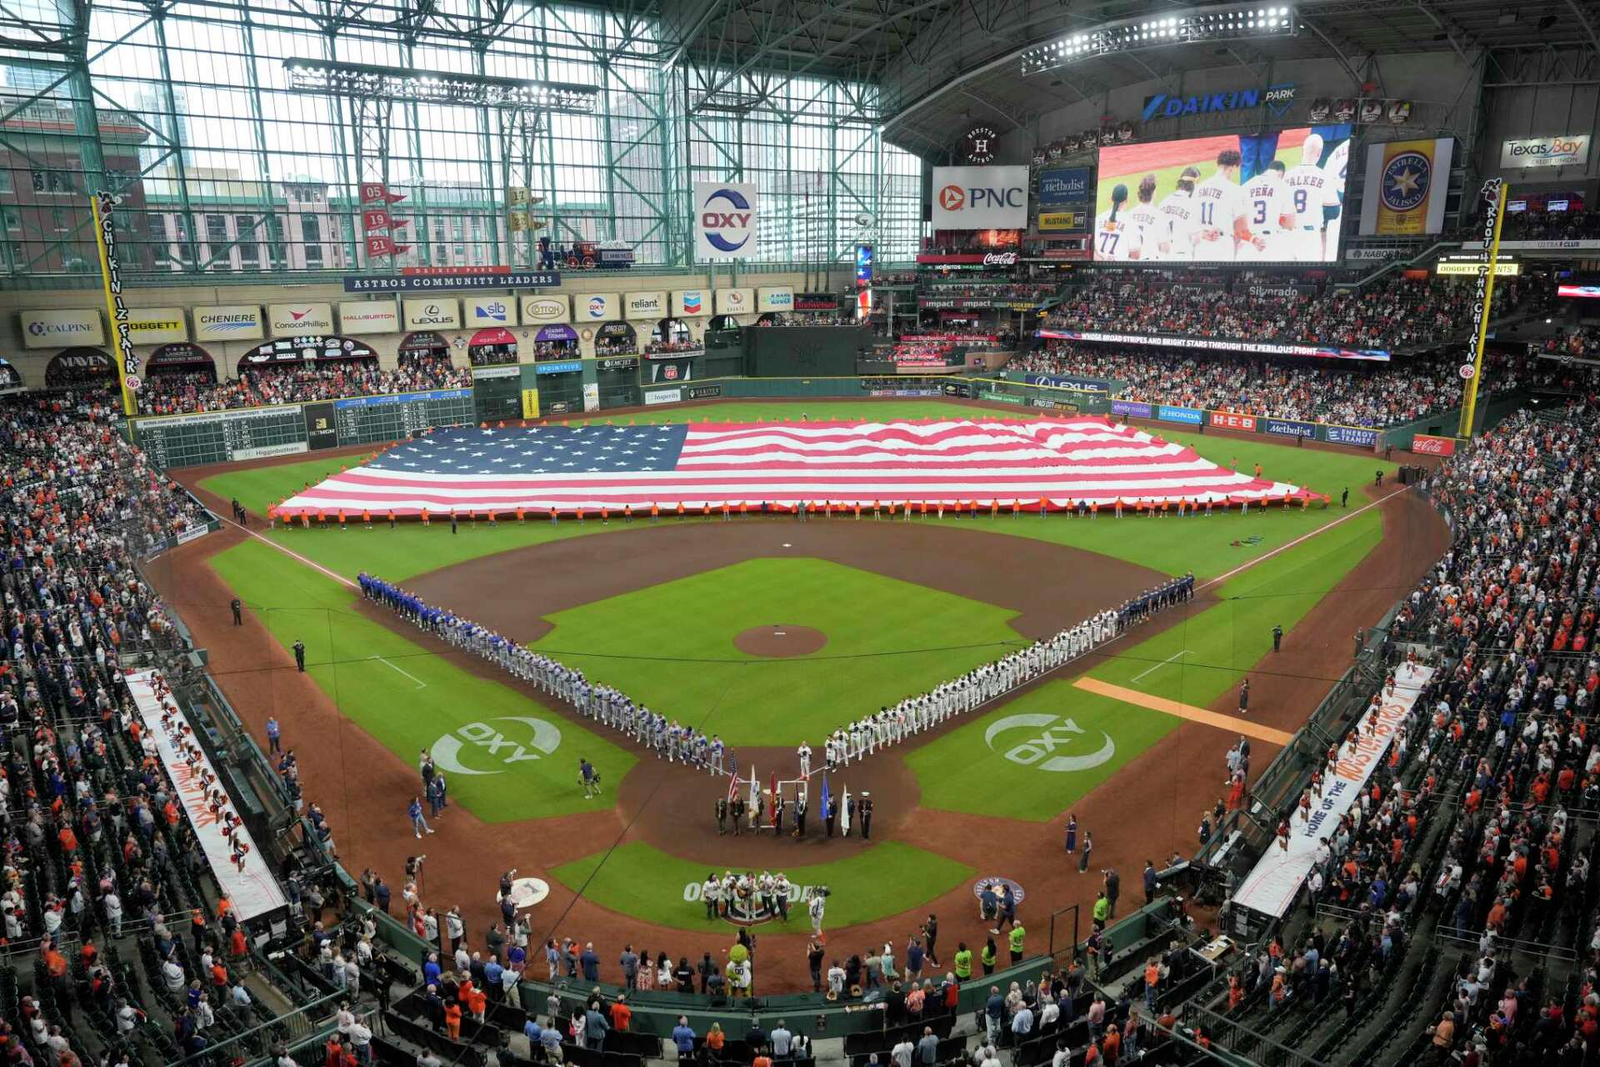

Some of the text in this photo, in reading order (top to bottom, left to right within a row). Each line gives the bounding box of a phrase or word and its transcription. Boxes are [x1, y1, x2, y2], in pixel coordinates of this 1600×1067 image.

[1265, 88, 1296, 101] PARK
[1165, 88, 1260, 117] DAIKIN
[967, 127, 995, 139] HOUSTON
[975, 139, 988, 152] H
[1508, 139, 1583, 157] Texas Bay
[1387, 157, 1428, 175] ESTRELLA
[1555, 156, 1578, 164] UNION
[1043, 178, 1084, 192] Methodist
[366, 186, 381, 197] 05
[968, 187, 1024, 208] PNC
[1198, 187, 1223, 199] SMITH
[1294, 189, 1307, 213] 8
[1387, 194, 1422, 206] JALISCO
[1201, 202, 1214, 225] 11
[1253, 200, 1266, 224] 3
[370, 214, 384, 225] 19
[702, 212, 752, 228] OXY
[1044, 216, 1071, 226] MUSTANG
[372, 240, 386, 250] 21
[1100, 232, 1119, 255] 77
[983, 252, 1018, 265] Coca-Cola
[354, 275, 553, 289] ASTROS COMMUNITY LEADERS
[488, 302, 506, 314] slb
[631, 299, 658, 309] reliant
[926, 299, 991, 308] impact impact
[200, 314, 256, 323] CHENIERE
[343, 313, 395, 321] HALLIBURTON
[411, 316, 454, 325] LEXUS
[46, 323, 94, 333] CALPINE
[128, 322, 178, 330] OGGETT
[275, 320, 329, 329] ConocoPhillips
[1082, 333, 1102, 341] WHOSE
[1102, 335, 1123, 343] BROAD
[1123, 336, 1148, 344] STRIPES
[1148, 337, 1162, 345] AND
[1162, 338, 1185, 347] BRIGHT
[1186, 340, 1207, 348] STARS
[1208, 341, 1241, 350] THROUGH
[1242, 343, 1256, 351] THE
[1257, 344, 1293, 354] PERILOUS
[59, 355, 108, 367] MAVEN
[1167, 410, 1200, 419] HONDA
[1269, 425, 1312, 437] Methodist
[1341, 429, 1373, 438] ENERGY
[456, 722, 541, 763] OXY
[1004, 718, 1086, 765] OXY
[1304, 780, 1347, 838] HOME OF THE
